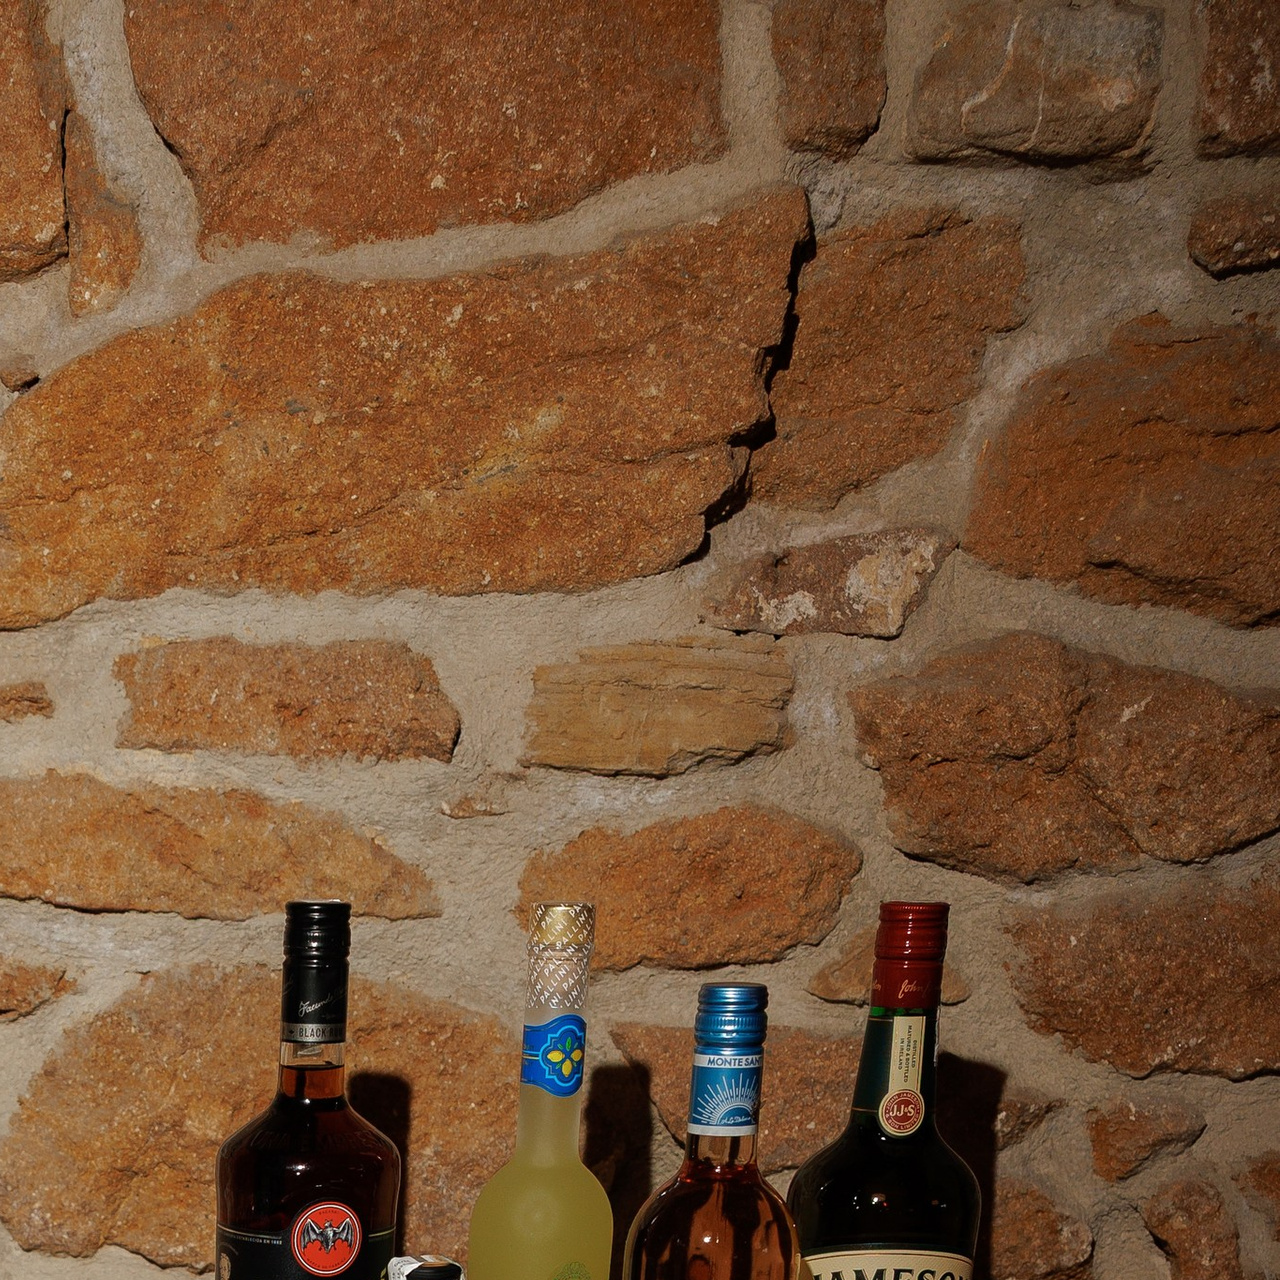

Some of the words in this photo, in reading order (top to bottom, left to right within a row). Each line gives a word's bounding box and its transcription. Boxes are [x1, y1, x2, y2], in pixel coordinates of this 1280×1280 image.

[533, 920, 568, 954] PALLINI
[539, 965, 570, 1004] PALLINI
[298, 1026, 327, 1039] BLACK
[905, 1025, 913, 1052] MATURED
[707, 1056, 744, 1068] MONTE
[744, 1055, 762, 1067] SAN
